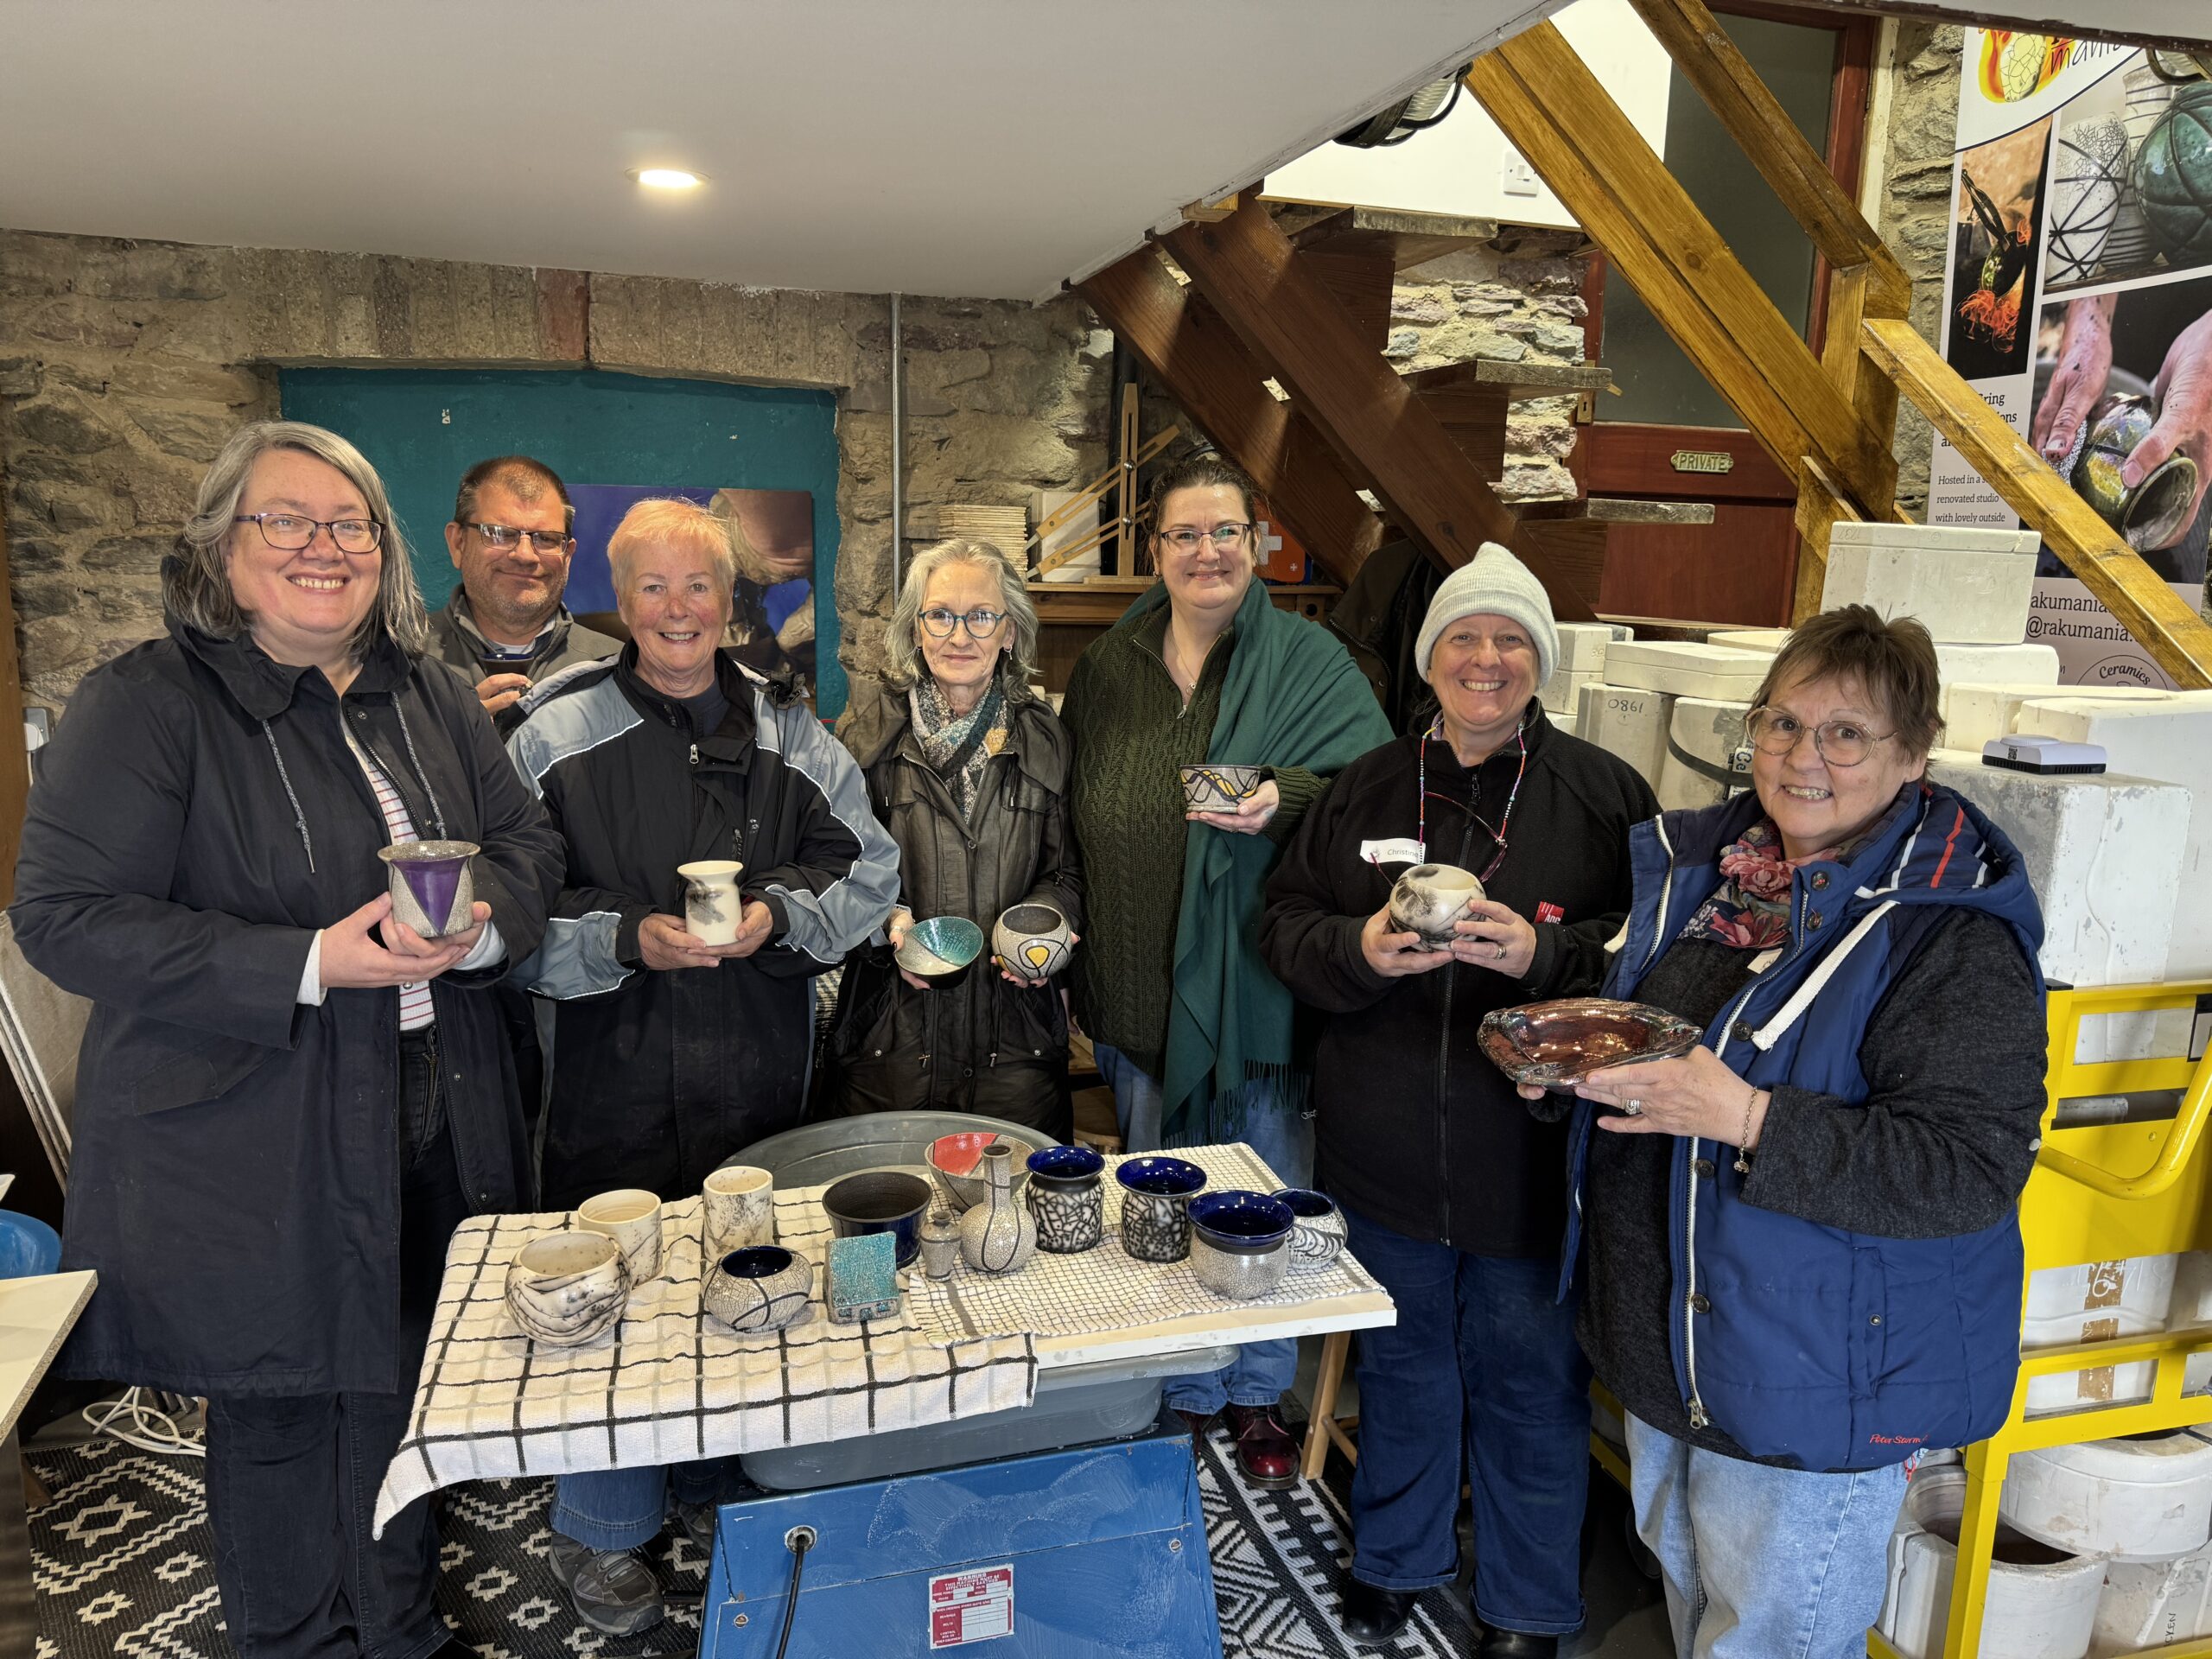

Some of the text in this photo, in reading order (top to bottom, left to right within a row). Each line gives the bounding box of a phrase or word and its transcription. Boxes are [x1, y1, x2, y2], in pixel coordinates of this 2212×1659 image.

[1679, 454, 1727, 471] PRIVATE
[1938, 474, 1966, 485] Hosted
[1967, 474, 1974, 484] in
[1936, 493, 1999, 504] renovated studio
[1936, 512, 2005, 524] with lovely outside
[2026, 616, 2139, 642] @rakumania.
[2100, 664, 2151, 685] Ceramics
[1387, 849, 1419, 858] Christine
[1869, 1433, 1921, 1445] Peter Storm
[957, 1573, 987, 1581] WARNING
